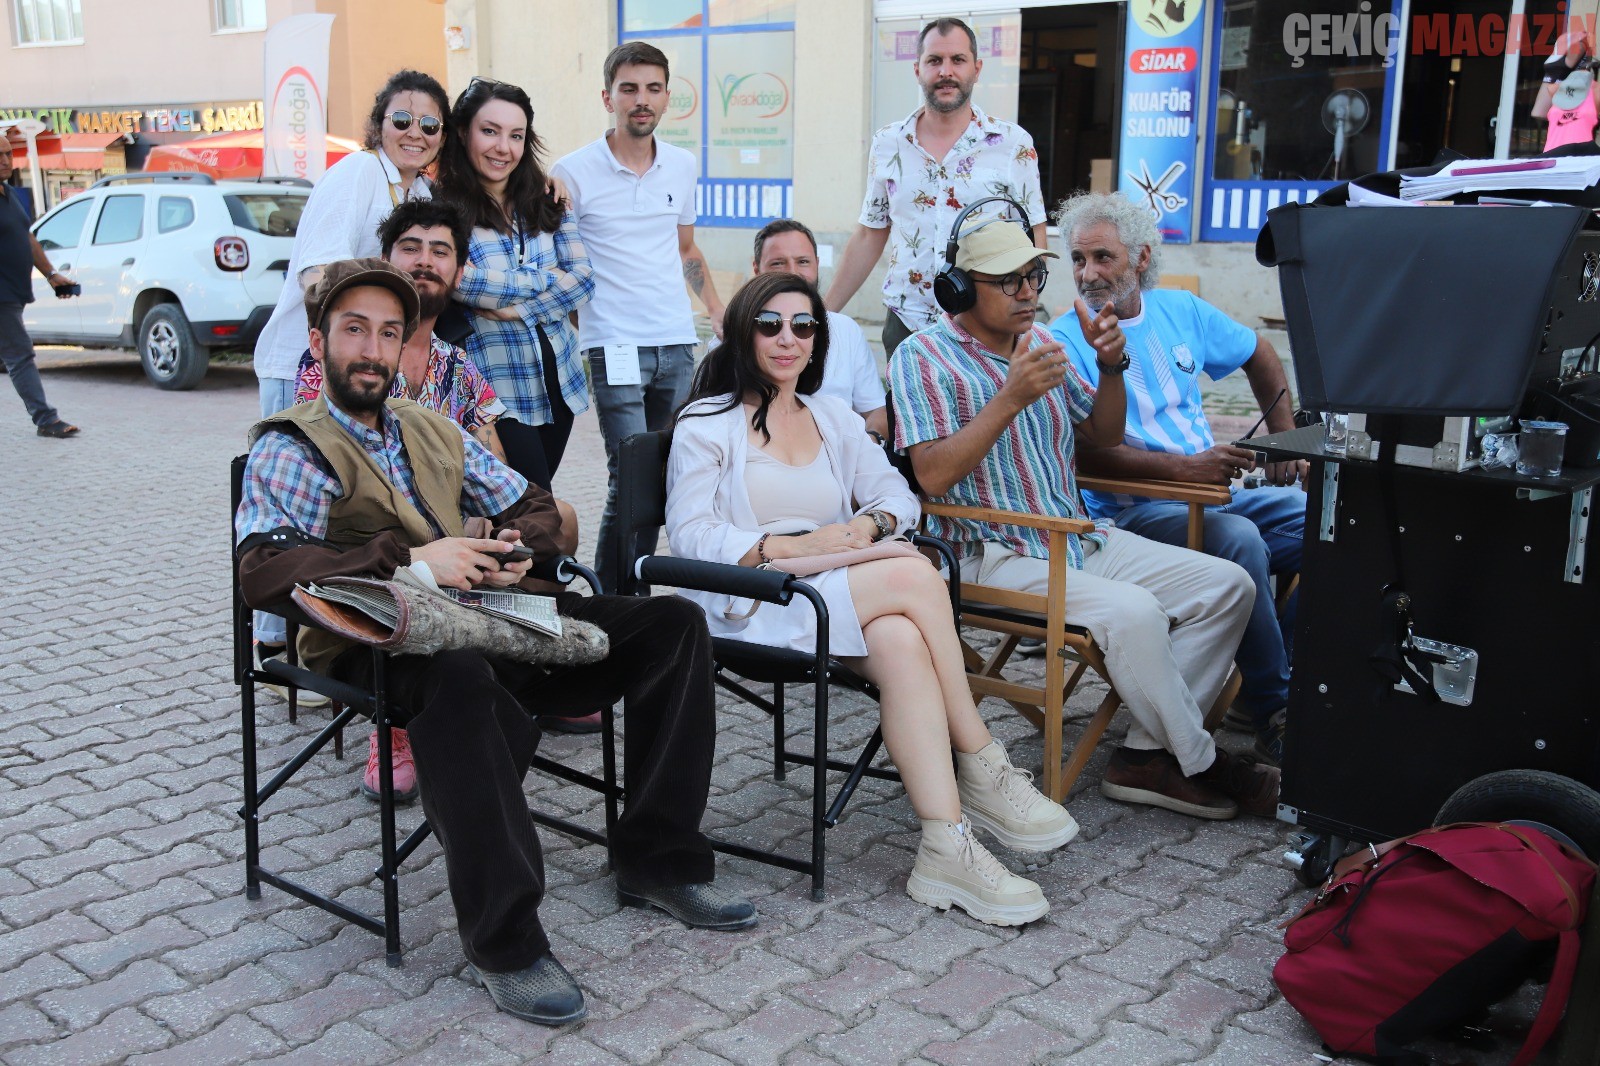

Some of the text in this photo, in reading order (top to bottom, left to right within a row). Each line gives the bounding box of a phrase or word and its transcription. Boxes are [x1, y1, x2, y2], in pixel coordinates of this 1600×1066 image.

[1139, 50, 1187, 71] SİDAR
[1128, 87, 1192, 112] KUAFÖR
[77, 110, 143, 133] MARKET
[146, 108, 201, 132] TEKEL
[1127, 116, 1191, 138] SALONU
